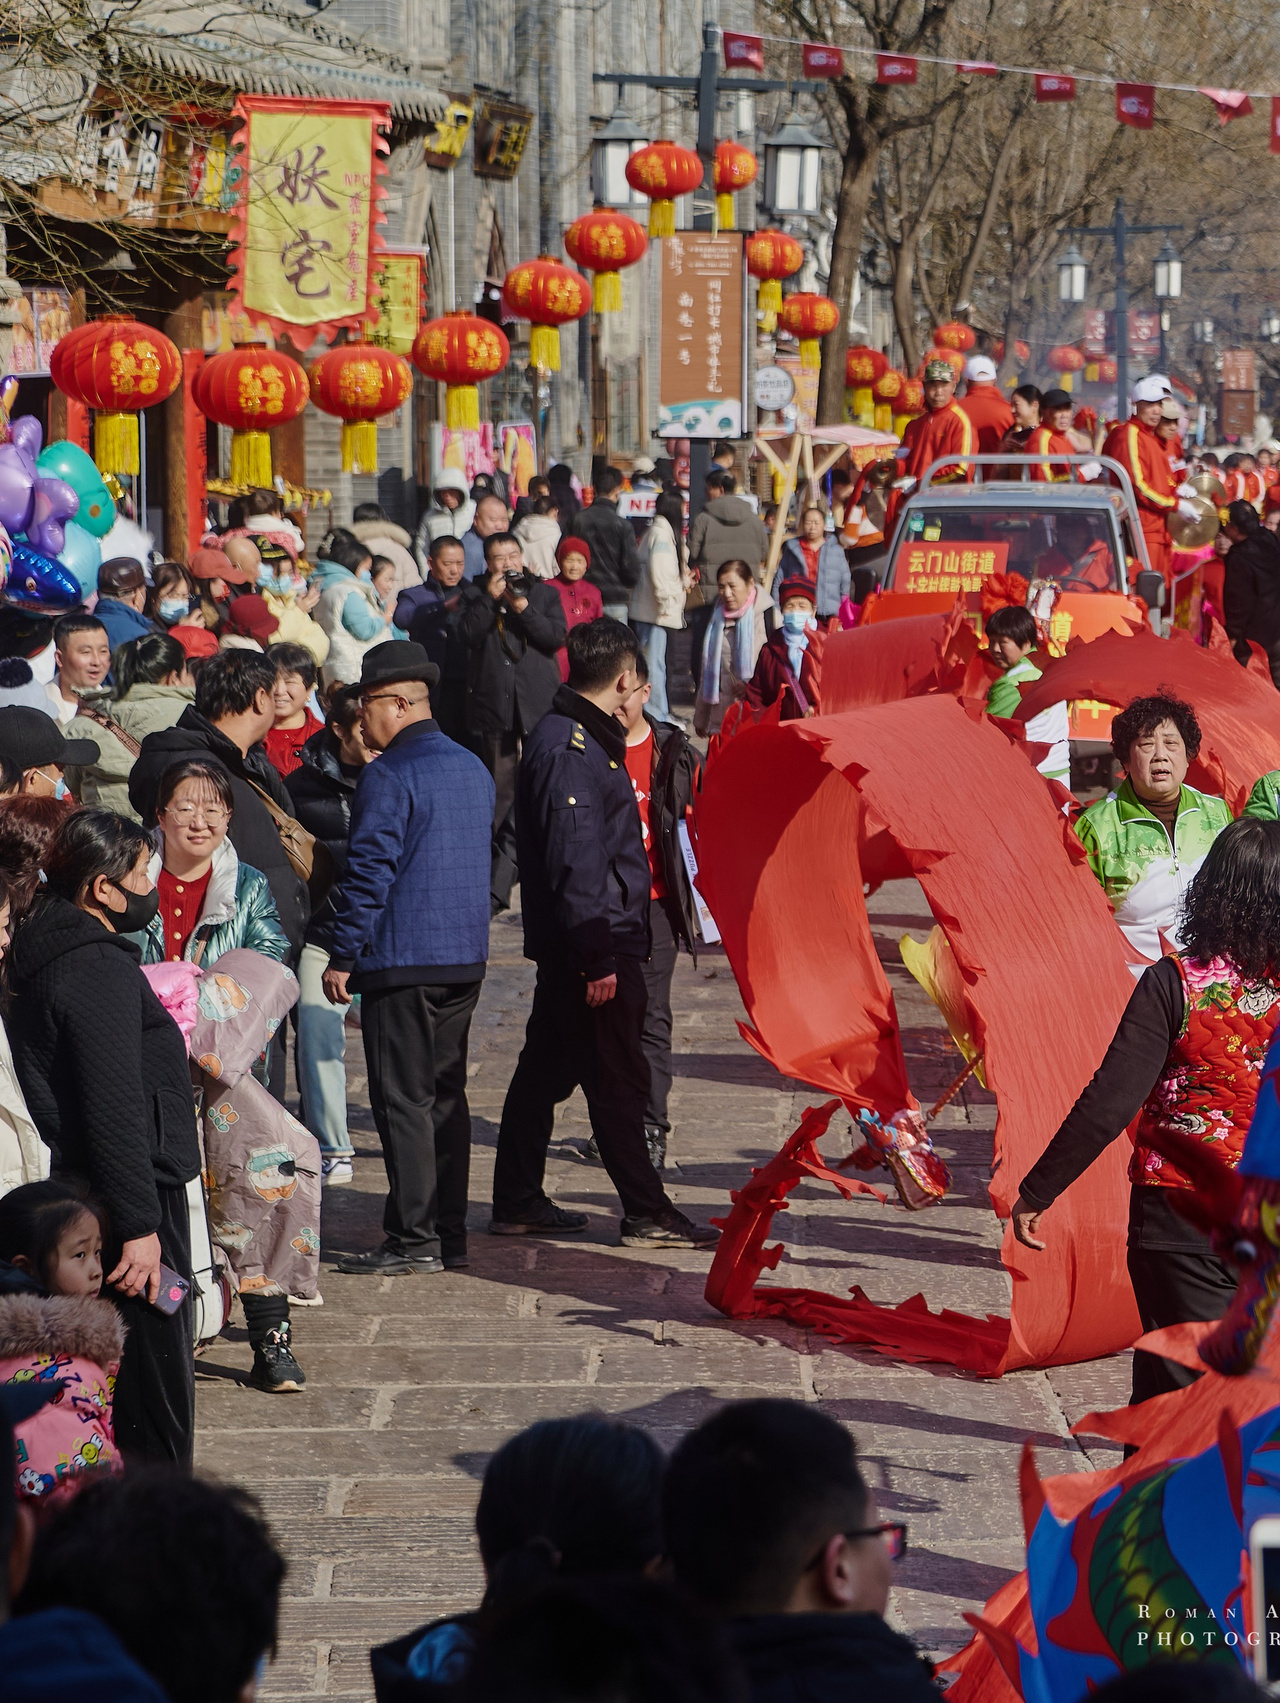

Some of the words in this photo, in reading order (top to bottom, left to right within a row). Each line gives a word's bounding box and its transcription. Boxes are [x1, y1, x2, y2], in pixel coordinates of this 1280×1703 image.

[343, 172, 370, 187] NPC
[908, 550, 996, 575] 云门山街道
[687, 848, 696, 872] PUZZLE
